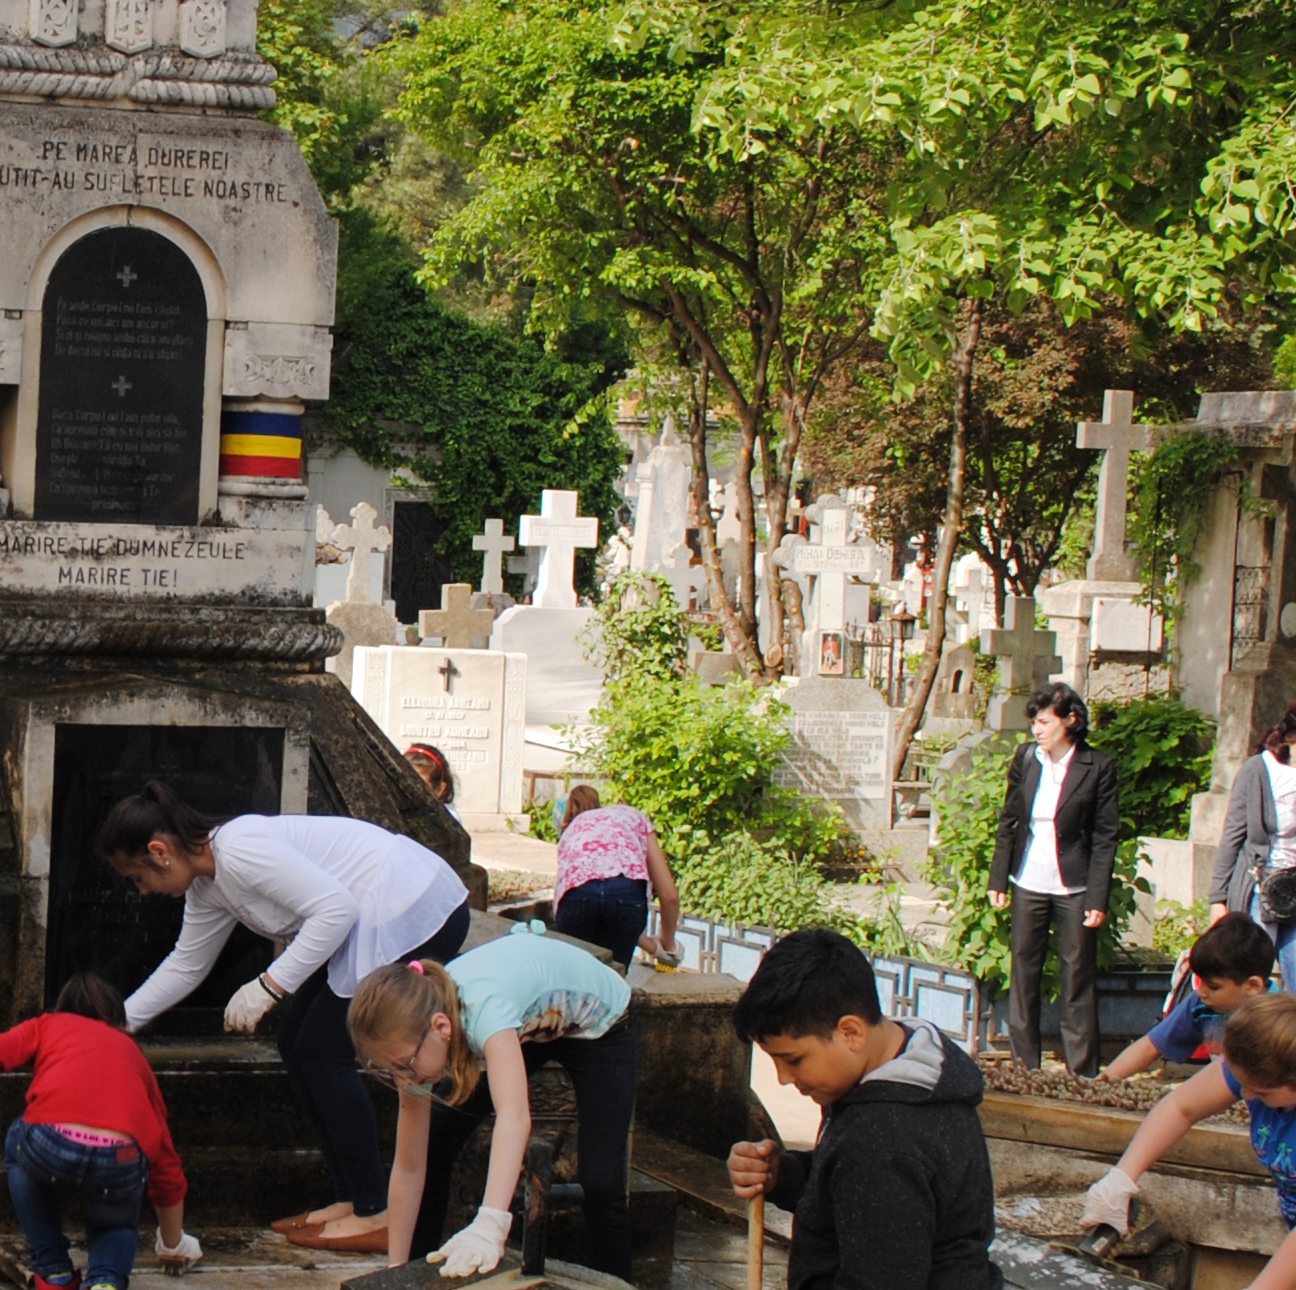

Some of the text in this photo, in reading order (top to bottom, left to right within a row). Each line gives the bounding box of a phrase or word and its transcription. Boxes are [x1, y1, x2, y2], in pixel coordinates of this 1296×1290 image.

[41, 141, 230, 171] PE MAREA DUREREI
[83, 172, 195, 198] SUFLETELE
[203, 179, 288, 204] NOASTRE
[116, 539, 246, 560] DUMNEZEULE
[58, 566, 179, 588] MARIRE TIE!
